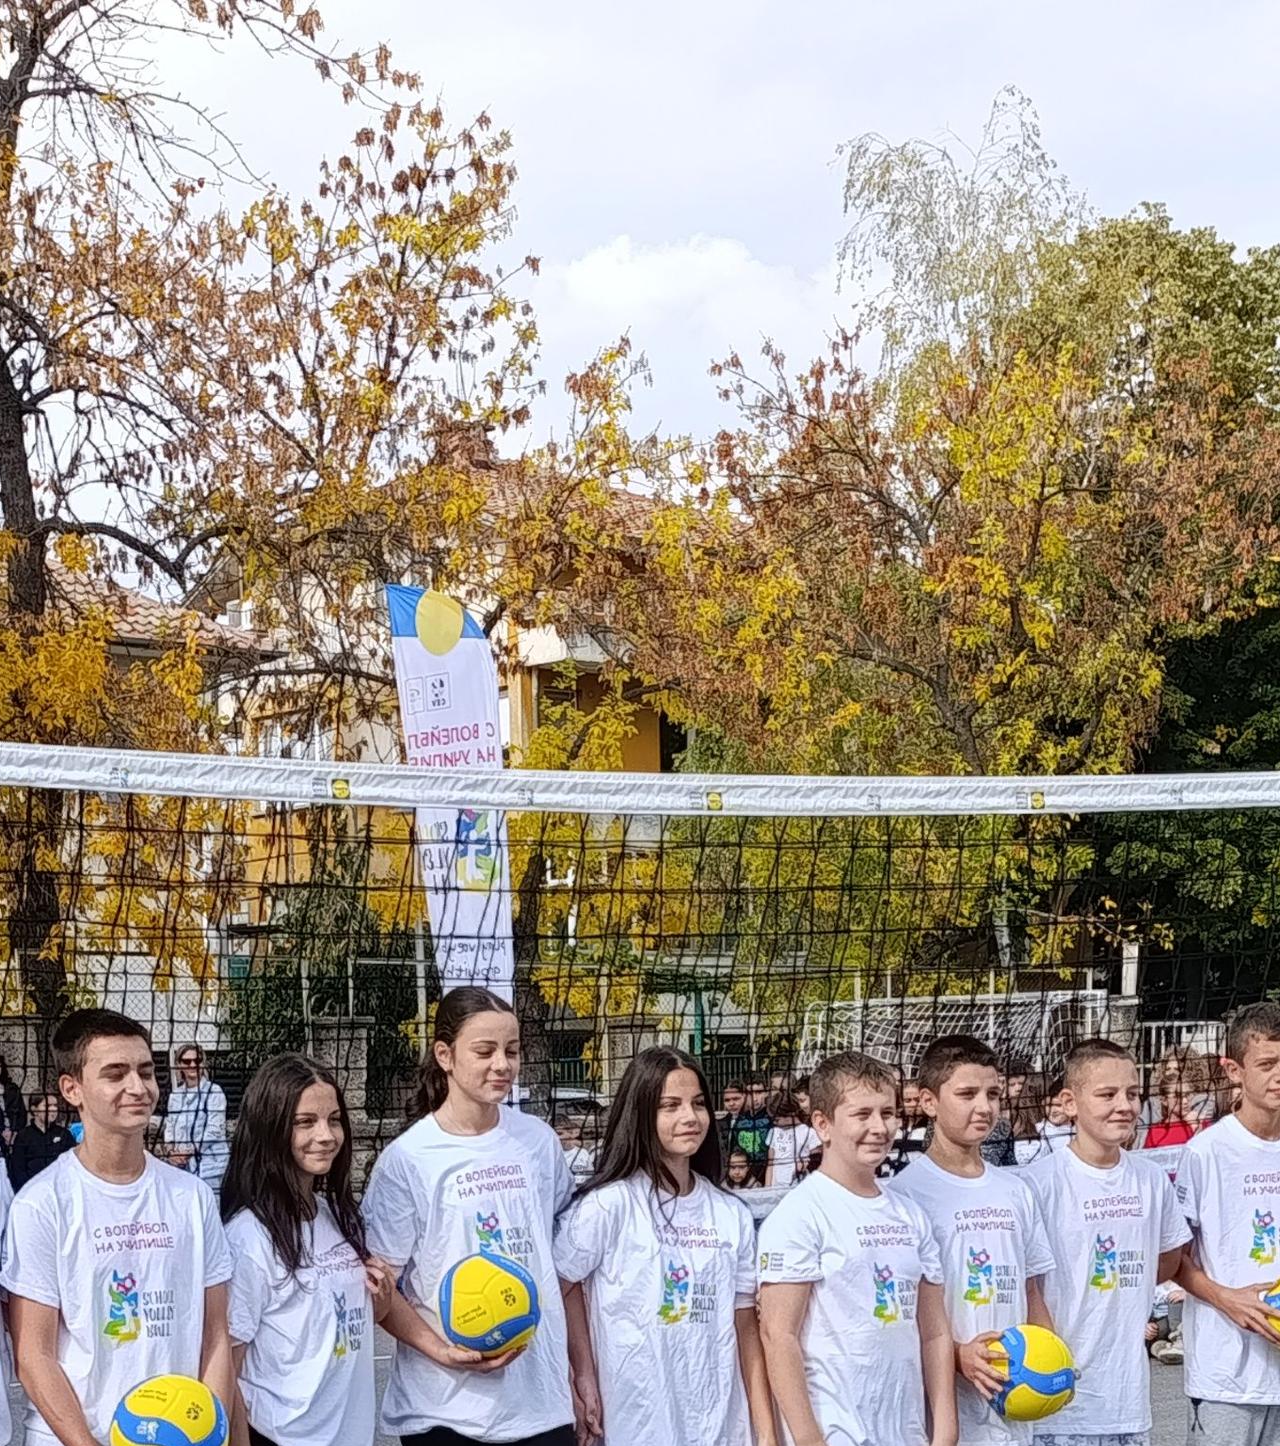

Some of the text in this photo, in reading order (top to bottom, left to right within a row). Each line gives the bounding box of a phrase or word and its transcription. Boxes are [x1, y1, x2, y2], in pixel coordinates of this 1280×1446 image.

[456, 1164, 524, 1185] С ВОЛЕЙБОЛ
[1244, 1174, 1250, 1184] С
[458, 1177, 528, 1200] НА УЧИЛИЩЕ
[1244, 1186, 1258, 1196] НА
[1083, 1194, 1142, 1210] С ВОЛЕЙБОЛ
[954, 1206, 1013, 1221] С ВОЛЕЙБОЛ
[1084, 1206, 1144, 1223] НА УЧИЛИЩЕ
[94, 1221, 170, 1239] С ВОЛЕЙБОЛ
[956, 1219, 1016, 1234] НА УЧИЛИЩЕ
[95, 1236, 174, 1254] НА УЧИЛИЩЕ
